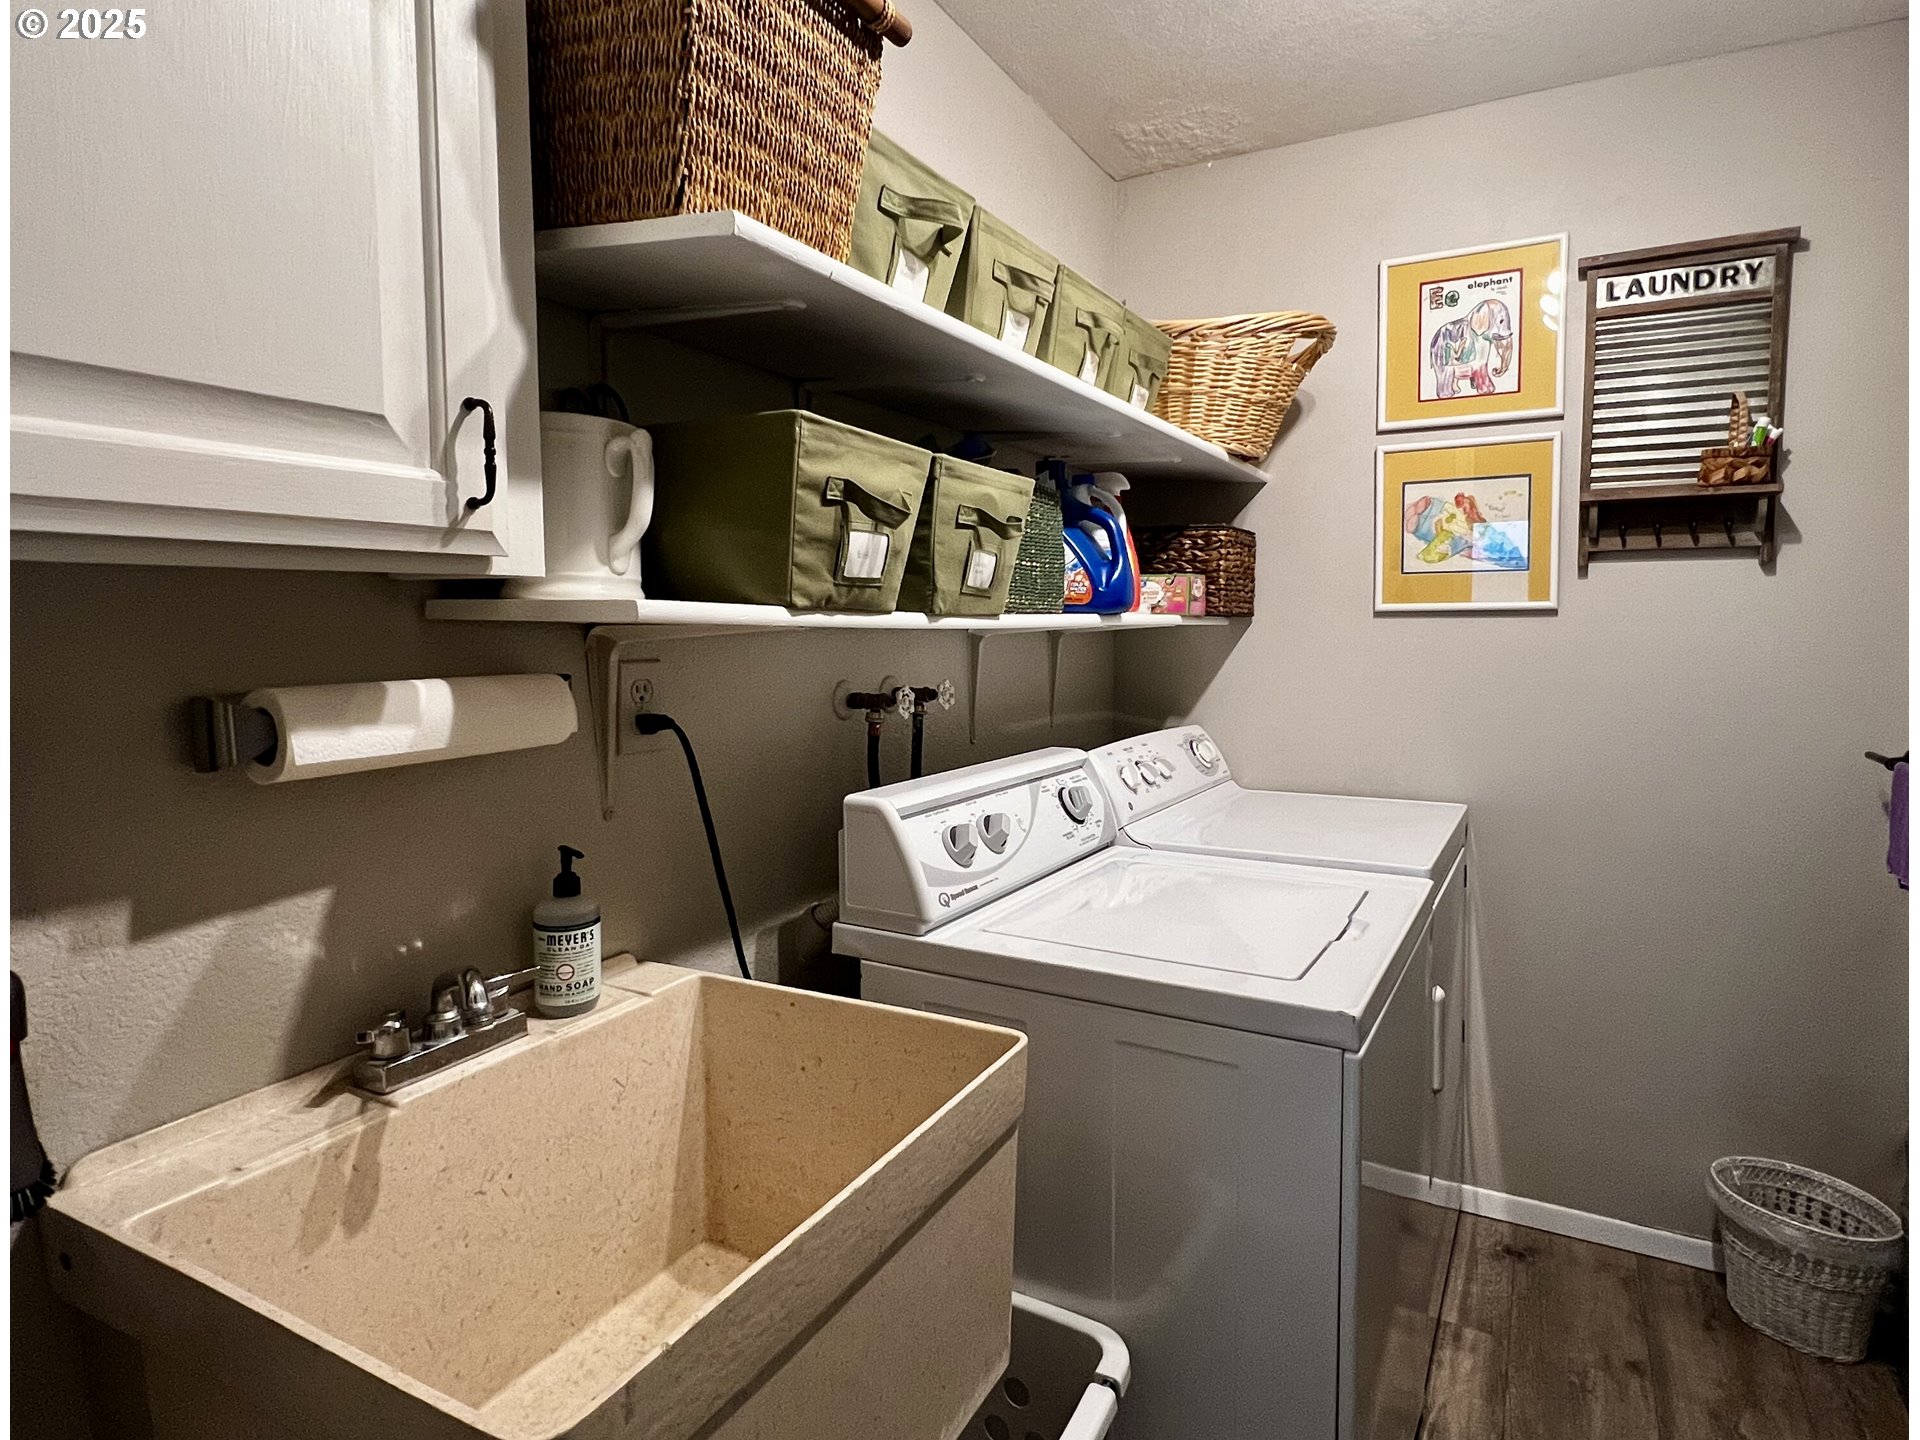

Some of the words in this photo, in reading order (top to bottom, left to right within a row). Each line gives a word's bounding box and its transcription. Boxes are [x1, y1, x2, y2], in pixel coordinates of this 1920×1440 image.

[1467, 276, 1513, 290] elephant
[1606, 260, 1763, 302] LAUNDRY
[546, 929, 594, 946] MEYER'S
[539, 984, 563, 992] HAND
[565, 977, 595, 991] SOAP
